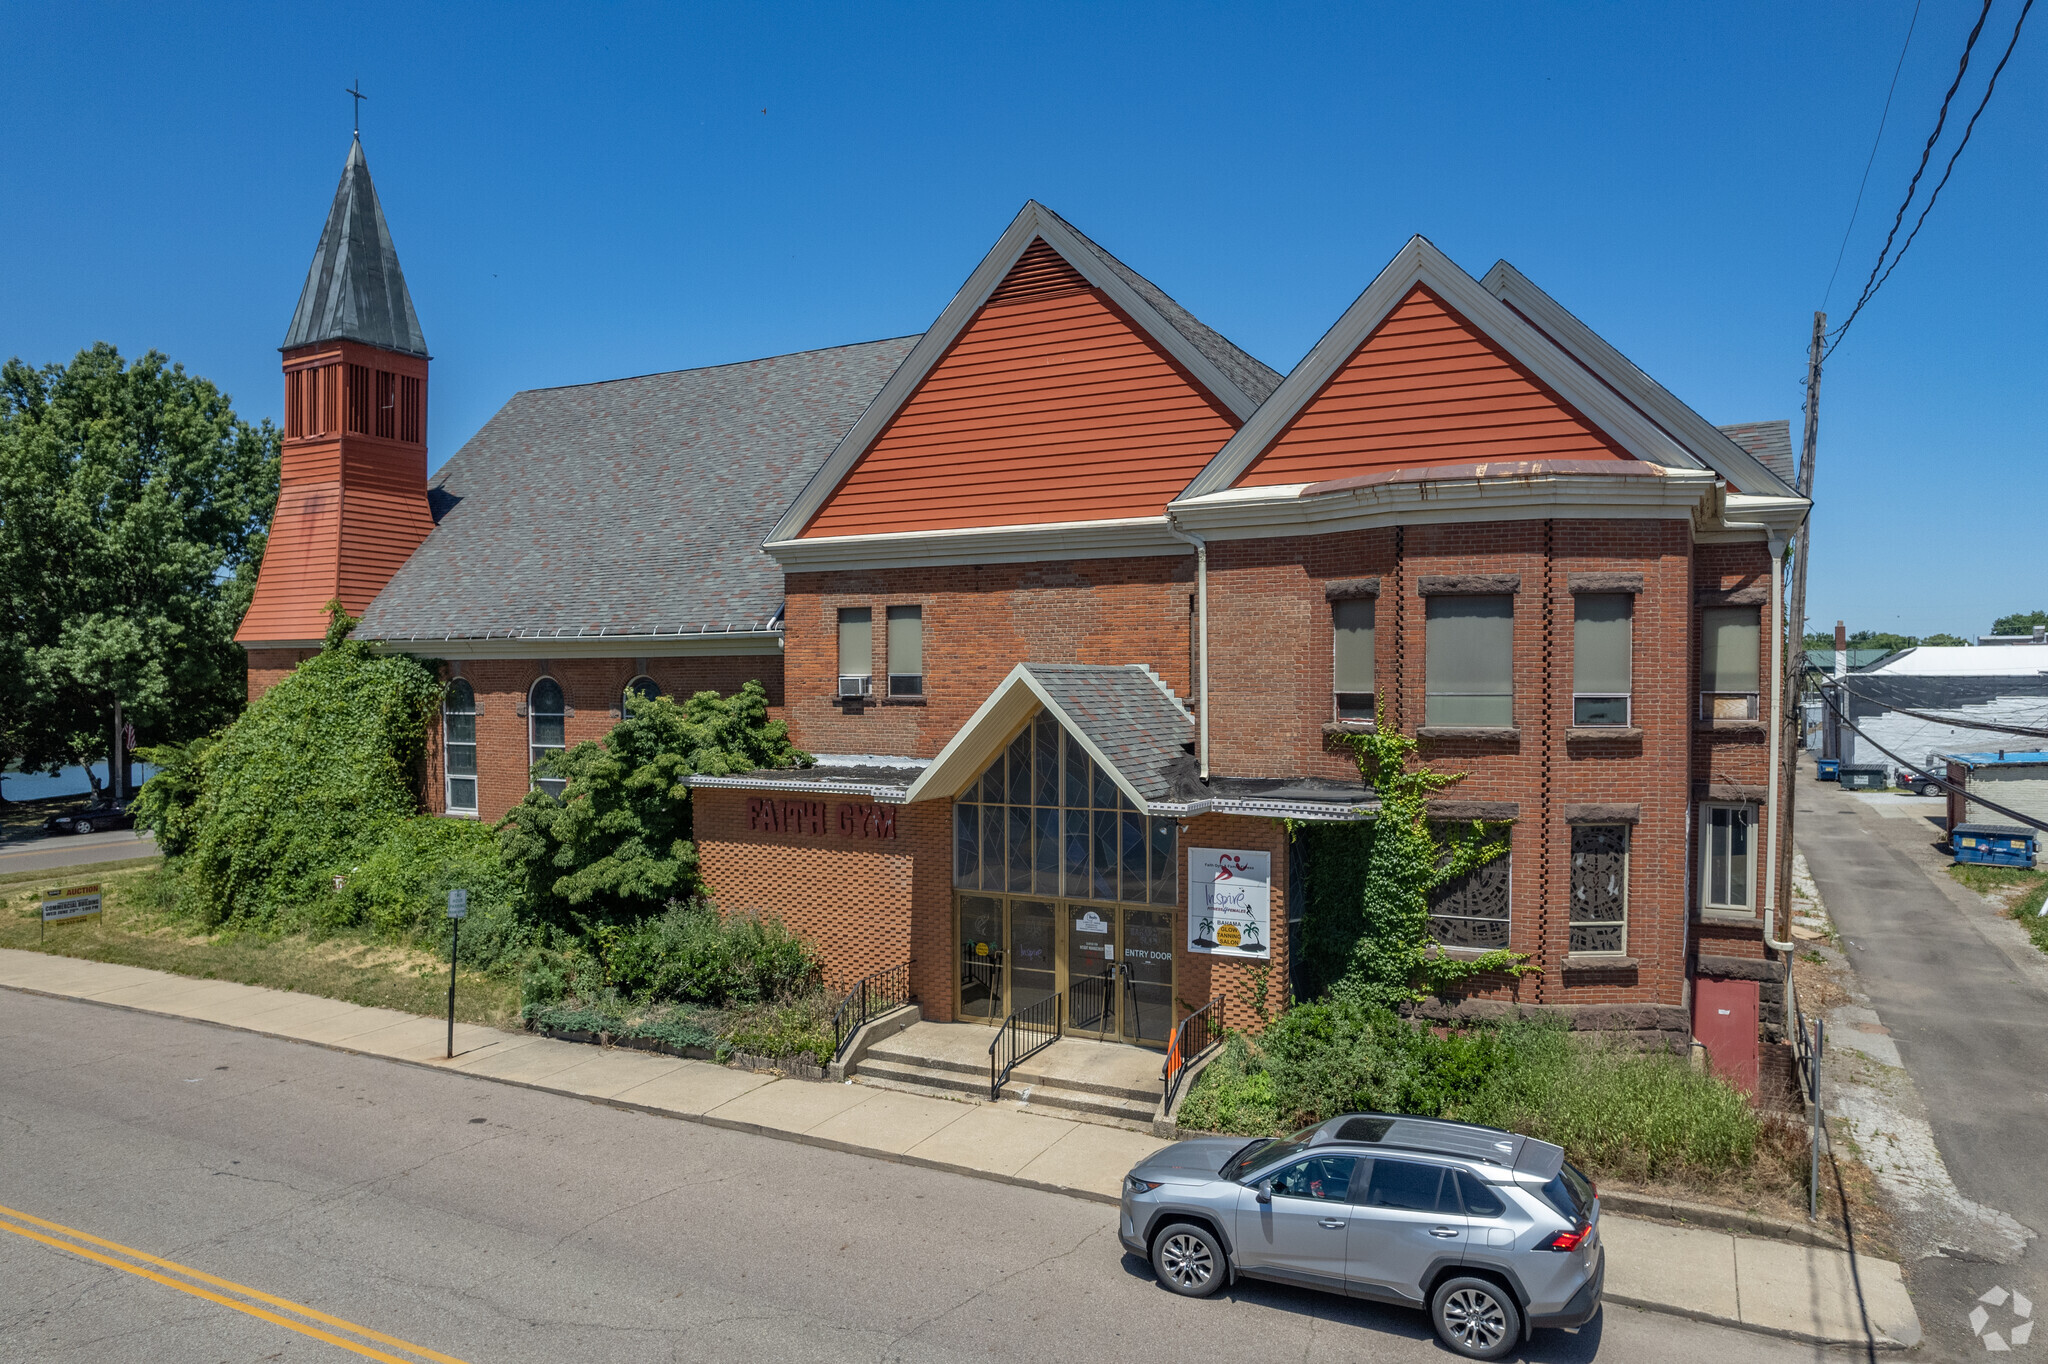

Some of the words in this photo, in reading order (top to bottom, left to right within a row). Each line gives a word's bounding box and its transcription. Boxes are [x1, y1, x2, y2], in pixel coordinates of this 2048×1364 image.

[747, 797, 825, 835] FAITH
[836, 803, 896, 839] GYM
[66, 885, 99, 895] AUCTION
[1205, 885, 1245, 909] Inspire
[45, 902, 77, 911] COMMERCIAL
[1125, 948, 1148, 958] ENTRY
[1150, 951, 1172, 960] DOOR
